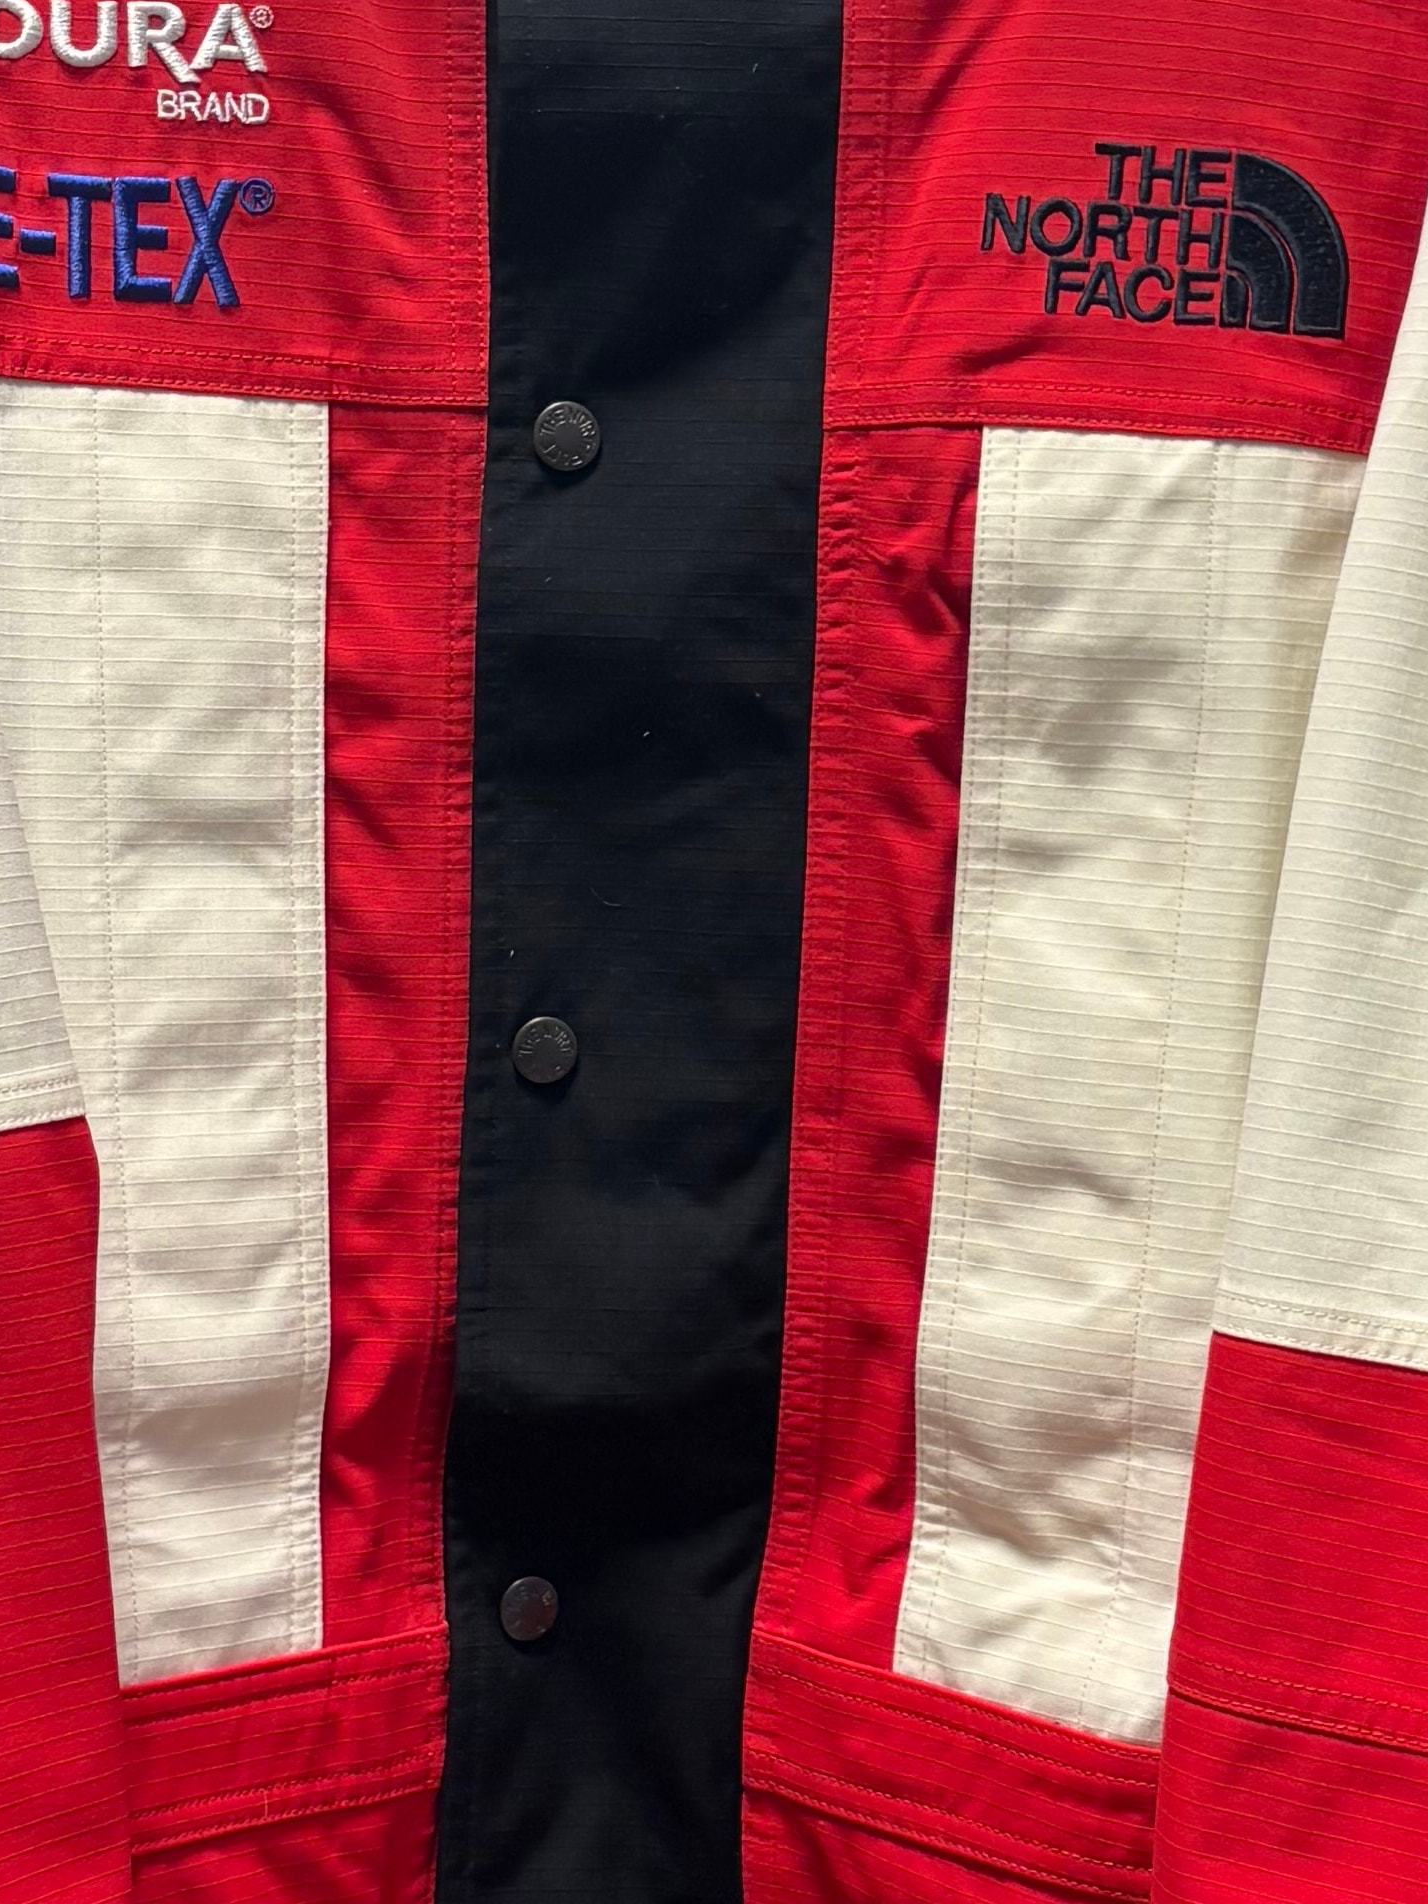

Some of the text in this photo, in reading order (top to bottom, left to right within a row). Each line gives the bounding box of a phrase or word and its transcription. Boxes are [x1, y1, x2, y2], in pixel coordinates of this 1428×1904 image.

[156, 89, 270, 125] BRAND
[1094, 142, 1232, 208] THE
[980, 192, 1226, 269] NORTH
[1044, 259, 1220, 326] FACE
